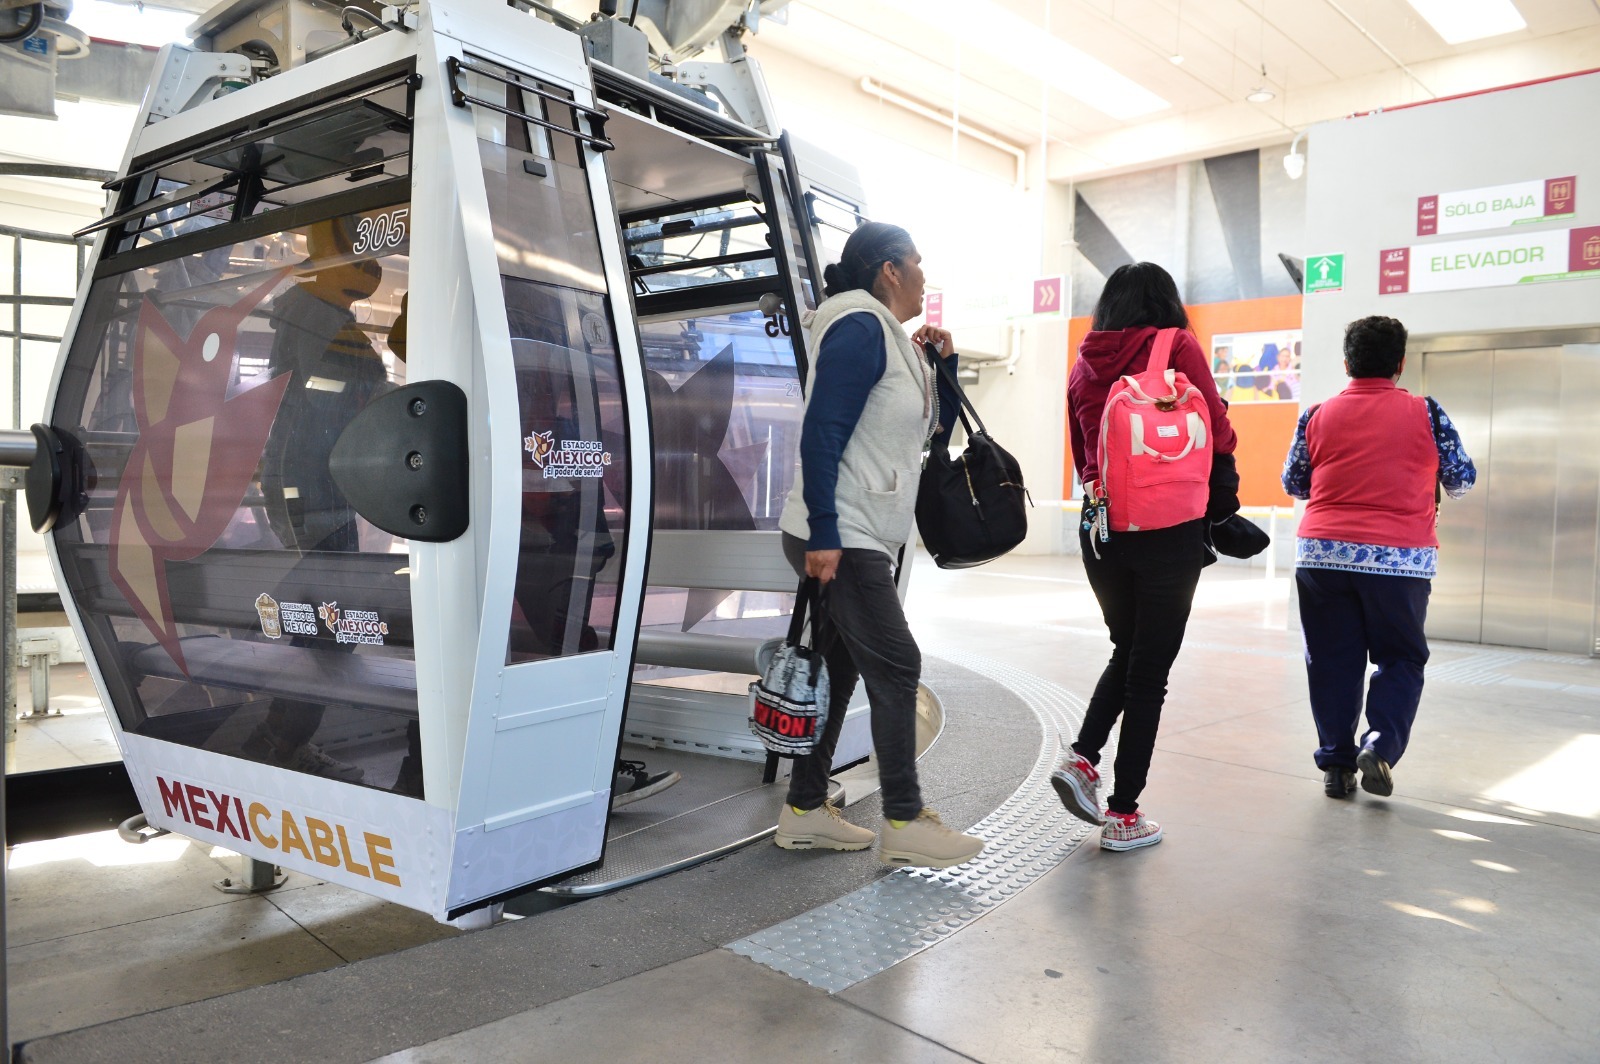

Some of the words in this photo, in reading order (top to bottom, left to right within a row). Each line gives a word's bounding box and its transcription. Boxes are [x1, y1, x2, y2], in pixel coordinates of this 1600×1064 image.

[1445, 201, 1487, 218] SÓLO
[1492, 195, 1536, 212] BAJA
[353, 208, 409, 255] 305
[1430, 246, 1544, 272] ELEVADOR
[562, 441, 590, 450] ESTADO
[592, 442, 602, 450] DE
[550, 451, 602, 465] MÉXICO
[544, 467, 553, 478] ¡El
[555, 467, 573, 478] poder
[574, 468, 583, 476] de
[583, 467, 603, 477] servir!
[282, 611, 305, 620] ESTADO
[306, 613, 315, 621] DE
[346, 611, 369, 619] ESTADO
[369, 612, 378, 620] DE
[339, 620, 380, 634] MÉXICO
[156, 775, 402, 888] MEXICABLE
